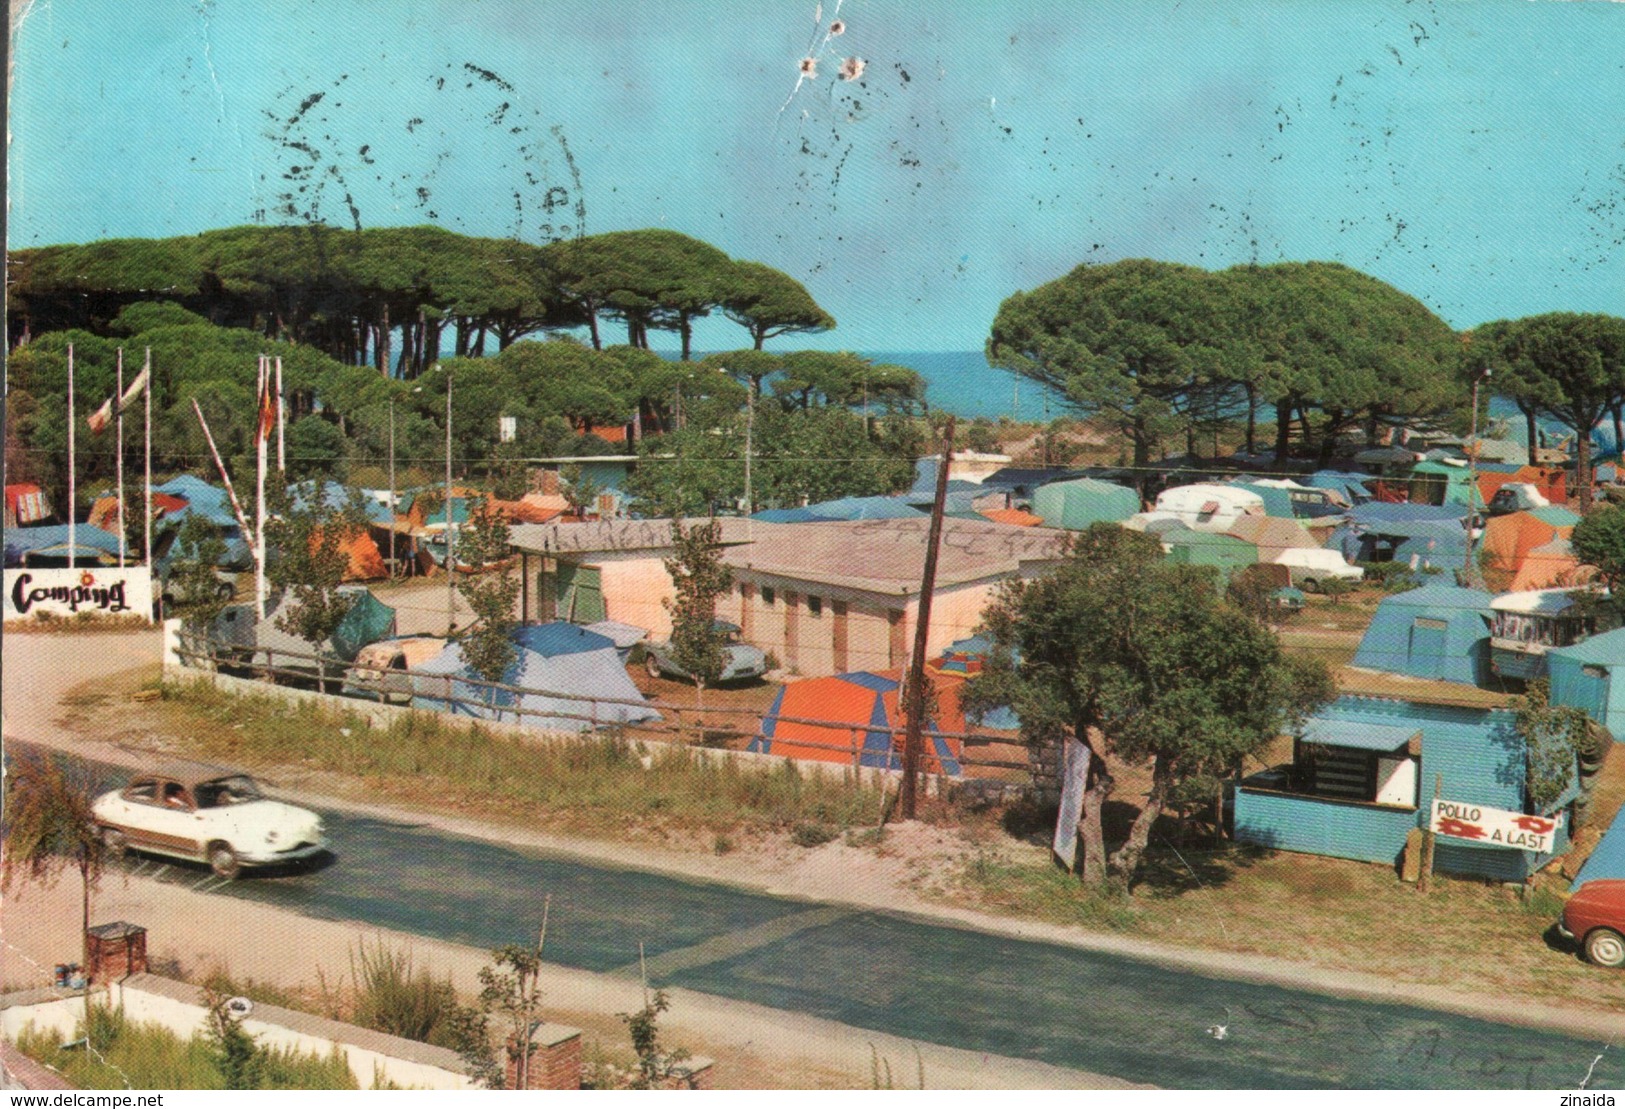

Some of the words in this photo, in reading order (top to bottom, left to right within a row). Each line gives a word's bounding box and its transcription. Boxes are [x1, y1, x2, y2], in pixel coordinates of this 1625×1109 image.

[1437, 802, 1481, 821] POLLO
[1492, 829, 1502, 842] A
[1507, 831, 1546, 849] LAST
